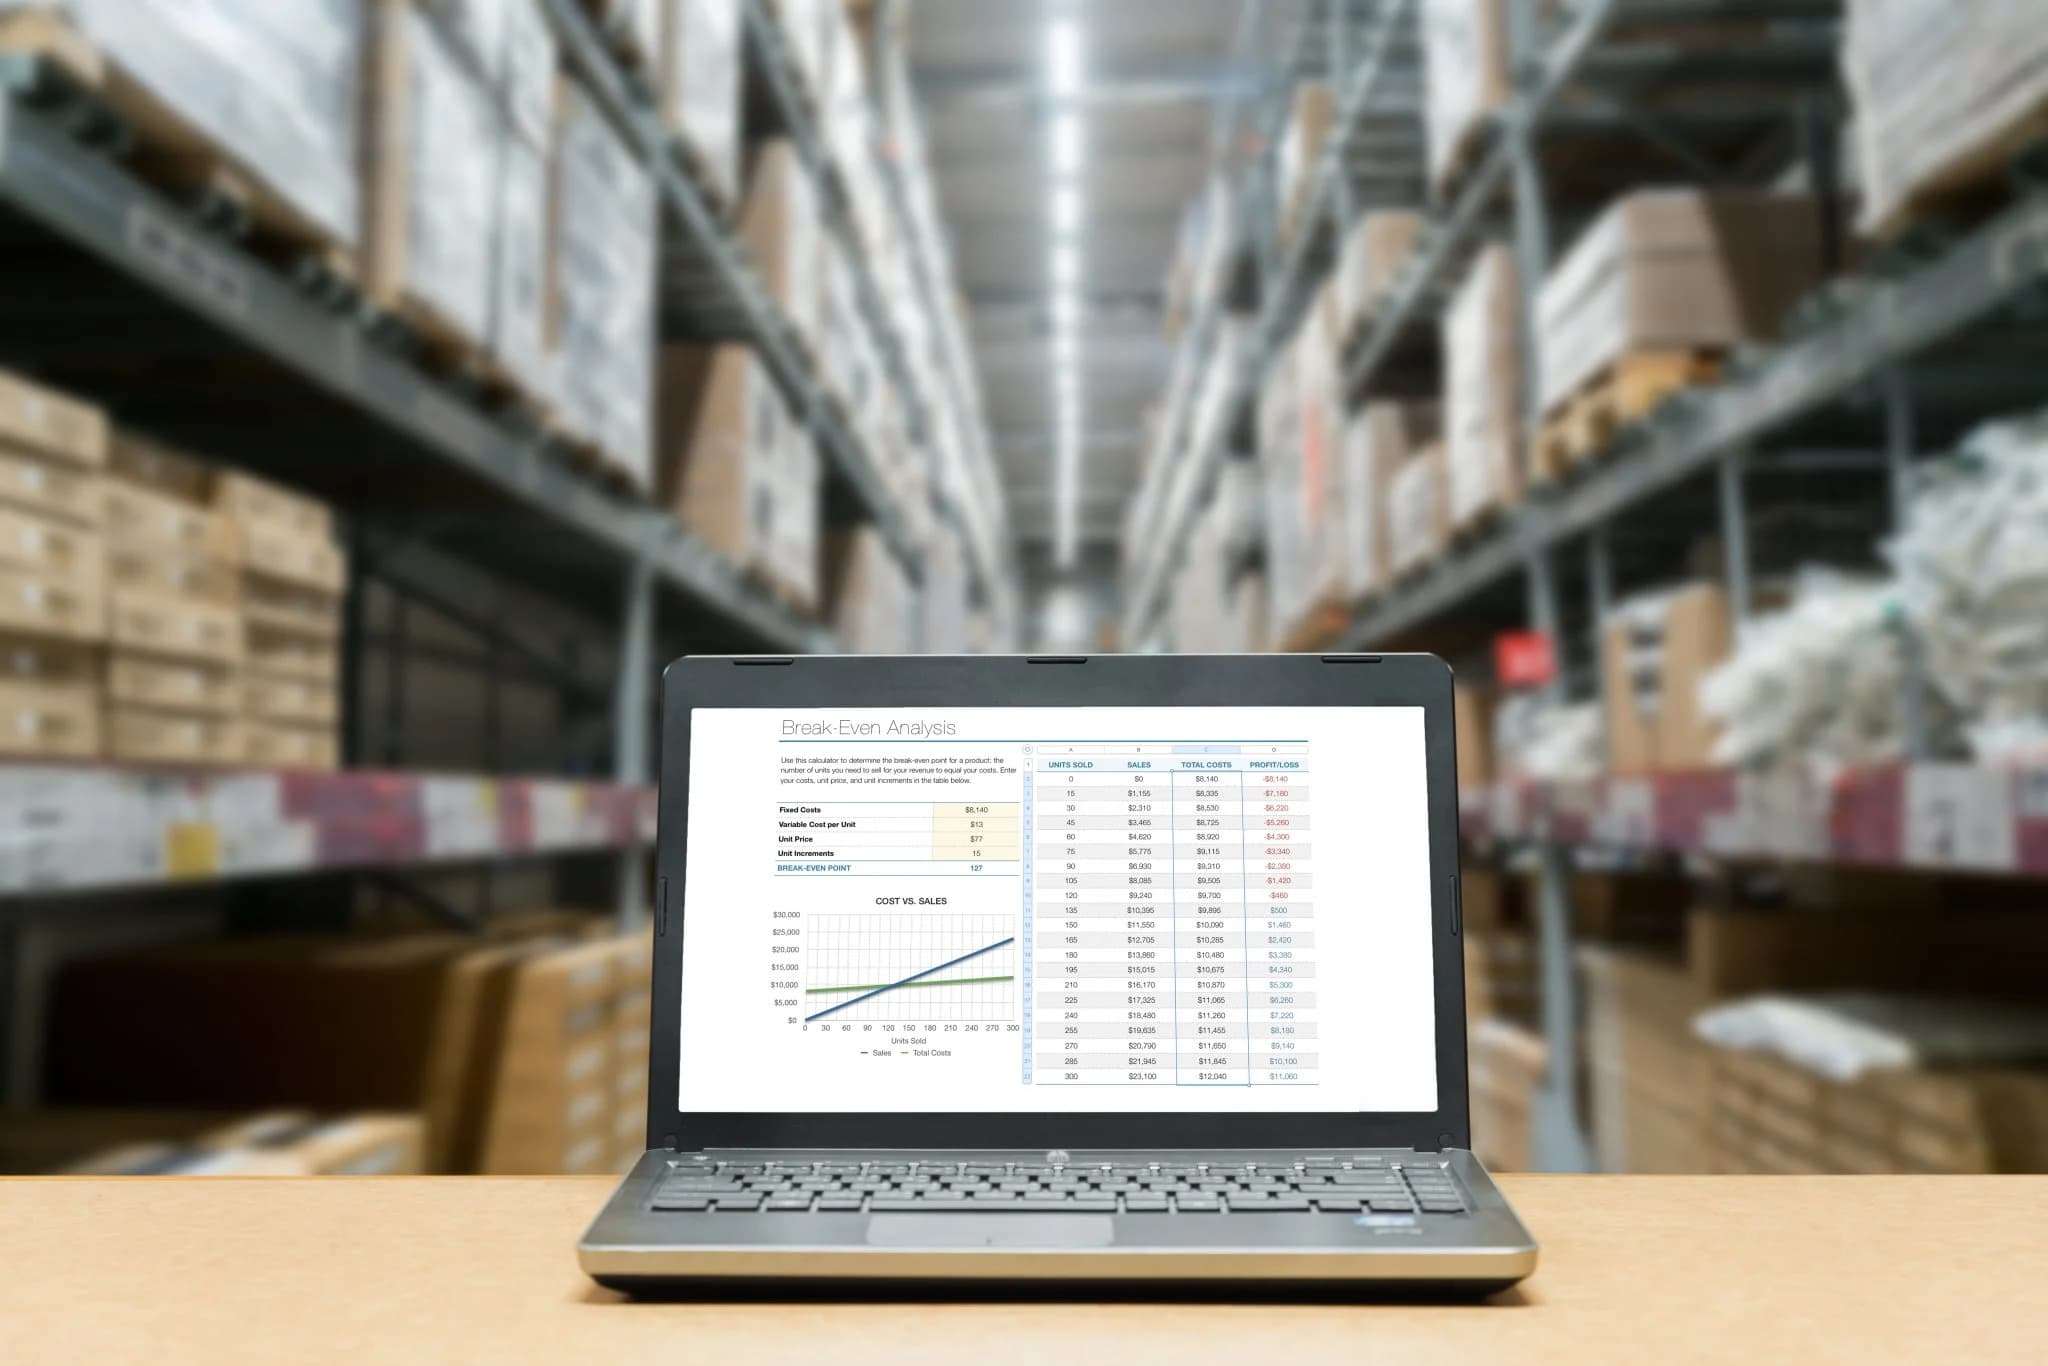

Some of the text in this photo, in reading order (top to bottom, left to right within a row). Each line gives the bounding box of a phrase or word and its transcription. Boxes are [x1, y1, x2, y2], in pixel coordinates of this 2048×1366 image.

[783, 720, 956, 738] Break-Even Analysis
[781, 756, 794, 764] Use
[795, 757, 807, 765] this
[808, 756, 839, 764] calculator
[840, 756, 847, 764] to
[849, 756, 880, 764] determine
[882, 757, 892, 765] the
[894, 757, 929, 765] break-even
[931, 757, 947, 765] point
[949, 756, 957, 764] for
[994, 756, 1004, 764] the
[1049, 761, 1093, 769] UNITS SOLD
[1128, 761, 1151, 769] SALES
[1181, 761, 1232, 769] TOTAL COSTS
[1250, 761, 1299, 769] PROFIT/LOSS
[781, 766, 805, 774] number
[807, 766, 813, 774] of
[815, 766, 830, 774] units
[832, 767, 843, 775] you
[845, 766, 861, 774] need
[871, 766, 881, 774] sell
[883, 766, 892, 774] for
[893, 768, 907, 776] your
[936, 767, 943, 775] to
[944, 767, 962, 775] equal
[963, 768, 977, 776] your
[1000, 766, 1016, 774] Enter
[817, 776, 829, 784] unit
[864, 776, 876, 784] unit
[878, 776, 912, 784] increments
[921, 776, 932, 784] the
[933, 776, 949, 784] table
[1069, 775, 1073, 783] 0
[1134, 775, 1143, 783] $0
[1067, 790, 1075, 798] 15
[780, 806, 821, 814] Fixed Costs
[1067, 805, 1075, 813] 30
[779, 820, 856, 830] Variable Cost per Unit
[970, 821, 983, 829] $13
[1066, 819, 1075, 827] 45
[779, 835, 813, 843] Unit Price
[970, 835, 983, 843] $77
[1067, 833, 1075, 841] 60
[778, 849, 834, 857] Unit Increments
[973, 849, 981, 857] 15
[1066, 848, 1075, 856] 75
[778, 864, 851, 872] BREAK-EVEN POINT
[971, 865, 983, 873] 127
[1067, 863, 1075, 871] 90
[1066, 877, 1077, 885] 105
[1065, 892, 1078, 900] 120
[876, 897, 901, 905] COST
[919, 898, 947, 906] SALES
[1066, 906, 1078, 914] 135
[1065, 921, 1078, 929] 150
[1065, 936, 1078, 944] 165
[1065, 951, 1078, 959] 180
[1065, 966, 1078, 974] 195
[1065, 981, 1078, 989] 210
[1065, 996, 1078, 1004] 225
[1065, 1012, 1078, 1020] 240
[788, 1017, 797, 1025] $0
[803, 1024, 1019, 1032] 0 30 60 90 120 150 180 210 240 270 300
[1065, 1026, 1078, 1034] 255
[891, 1037, 926, 1045] Units Sold
[1065, 1042, 1078, 1050] 270
[873, 1049, 891, 1057] Sales
[913, 1049, 951, 1057] Total Costs
[1065, 1057, 1078, 1065] 285
[1065, 1073, 1078, 1081] 300
